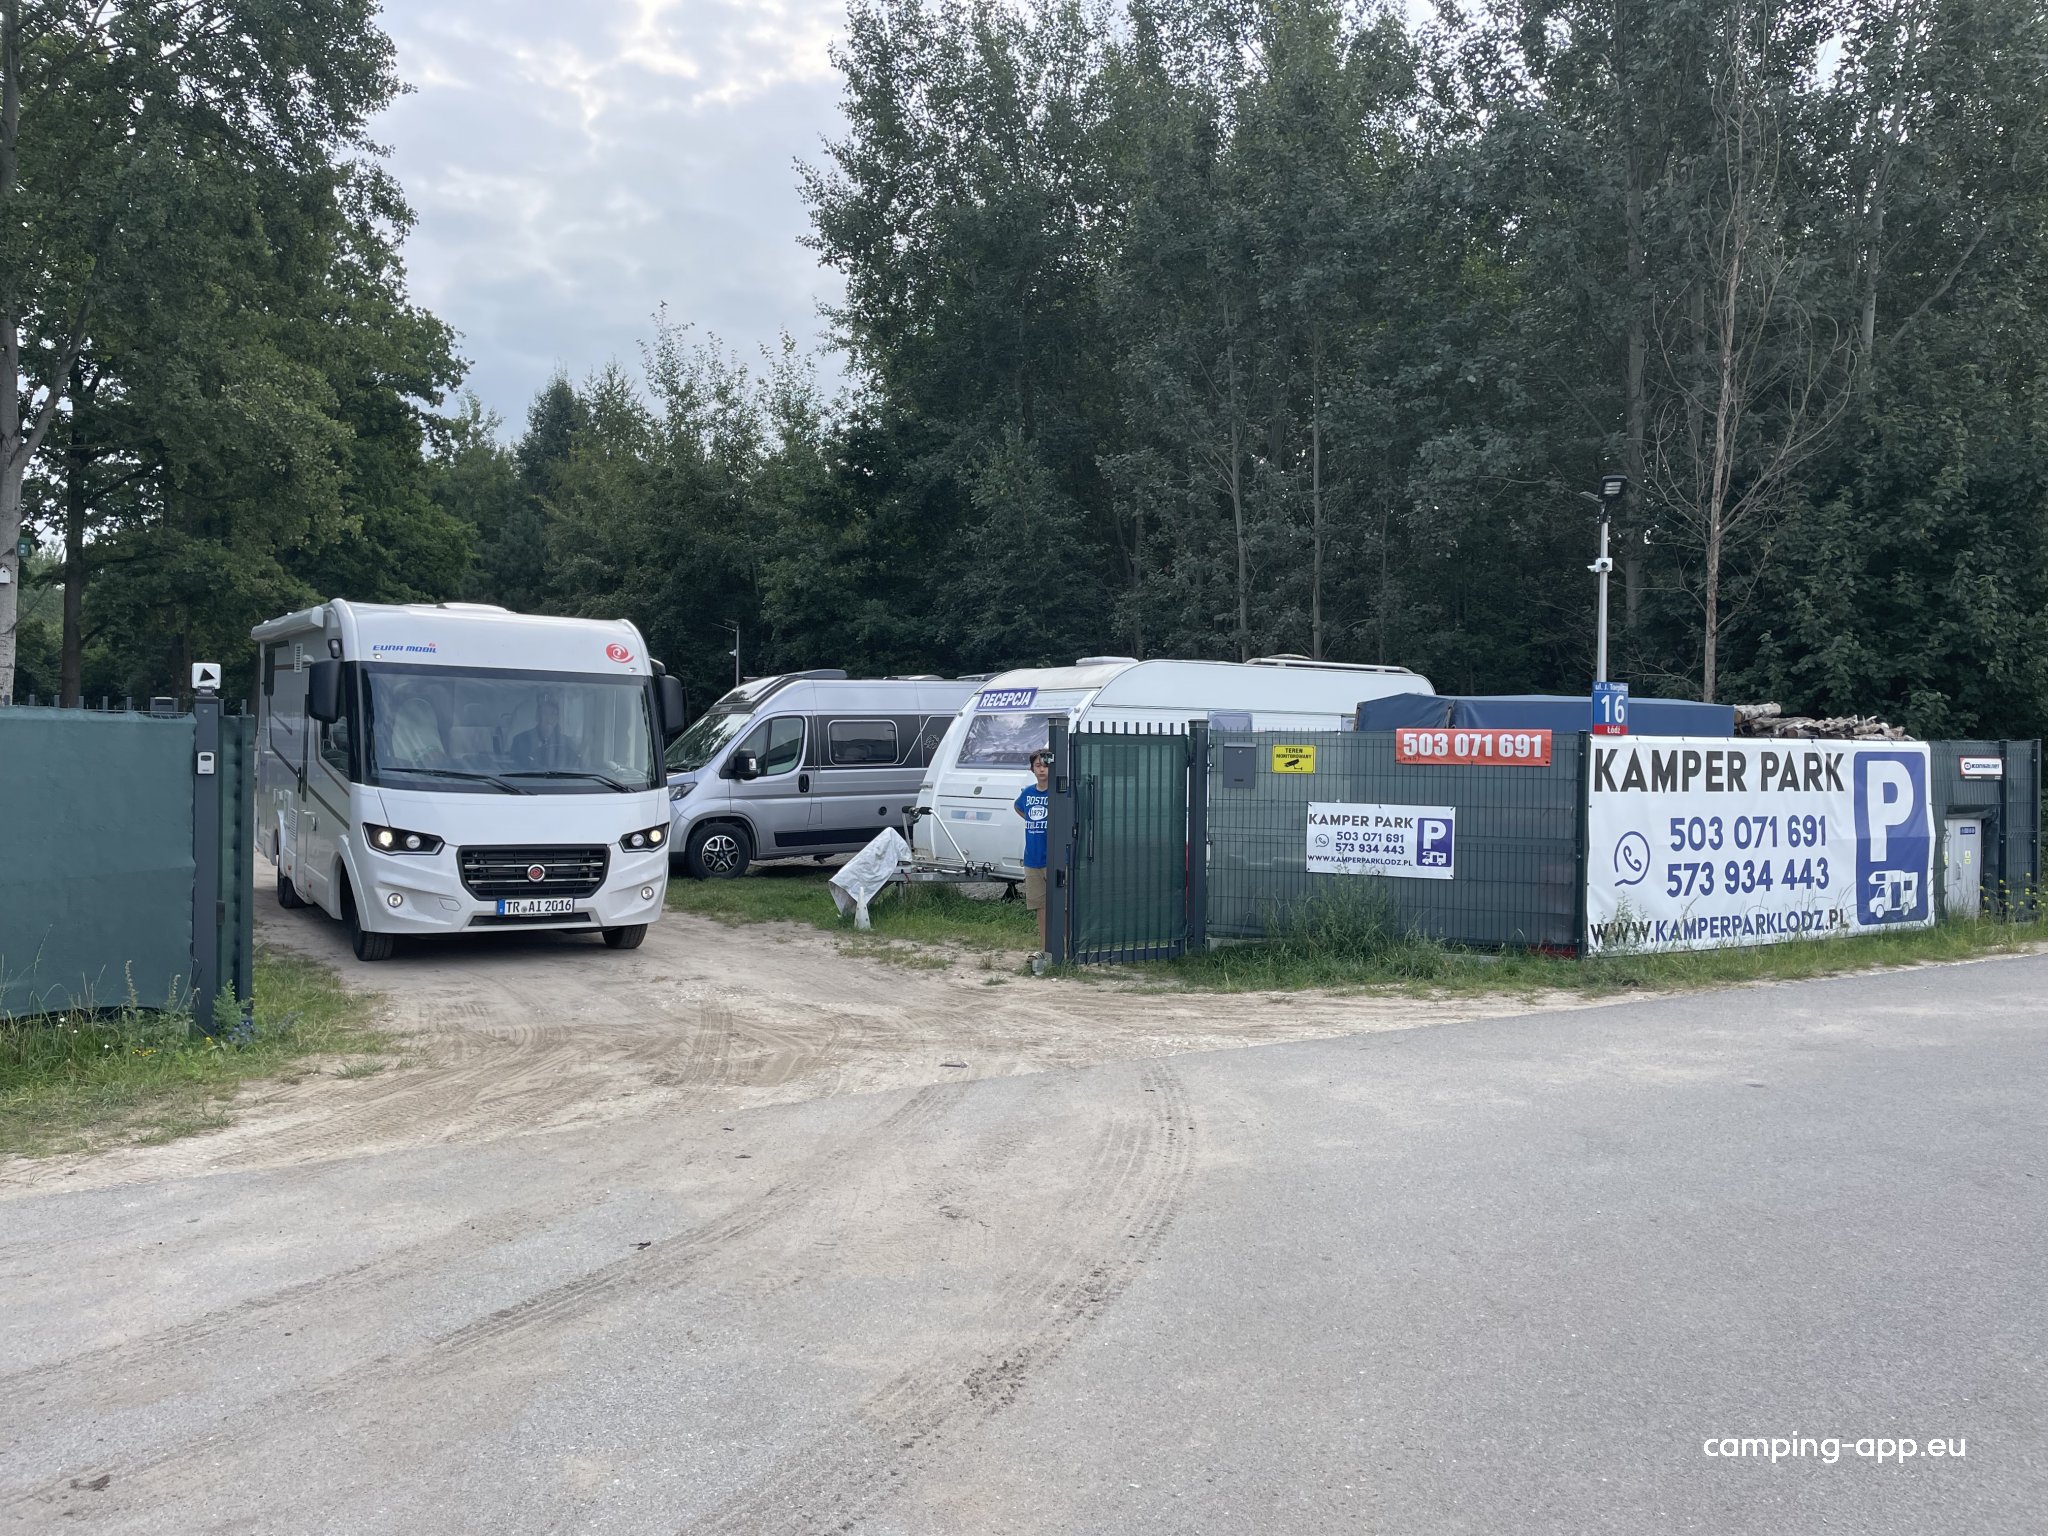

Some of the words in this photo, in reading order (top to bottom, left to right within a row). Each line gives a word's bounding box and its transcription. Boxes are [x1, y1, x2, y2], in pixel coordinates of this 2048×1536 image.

[405, 645, 438, 654] MOBIL
[980, 691, 1032, 707] RECEPCJA
[1601, 694, 1625, 724] 16
[1403, 732, 1449, 757] 503
[1454, 732, 1493, 757] 071
[1498, 733, 1542, 758] 691
[1593, 747, 1748, 794] KAMPER
[1760, 750, 1845, 792] PARK
[1026, 795, 1049, 806] BOSTO
[1308, 813, 1370, 827] KAMPER
[1374, 815, 1414, 829] PARK
[1336, 831, 1359, 841] 503
[1362, 832, 1382, 843] 071
[1385, 833, 1404, 844] 691
[1669, 815, 1724, 852] 503
[1733, 815, 1778, 849] 071
[1787, 814, 1827, 847] 691
[1335, 842, 1355, 852] 573
[1358, 843, 1380, 854] 934
[1383, 844, 1405, 855] 443
[1307, 854, 1413, 867] WWW.KAMPERPARKLODZ.PL
[1666, 861, 1715, 898] 573
[1724, 859, 1773, 895] 934
[1781, 856, 1830, 891] 443
[506, 901, 520, 913] TR
[528, 901, 542, 913] AI
[544, 899, 572, 912] 2016
[1590, 908, 1849, 947] WWW.KAMPERPARKLODZ.PL
